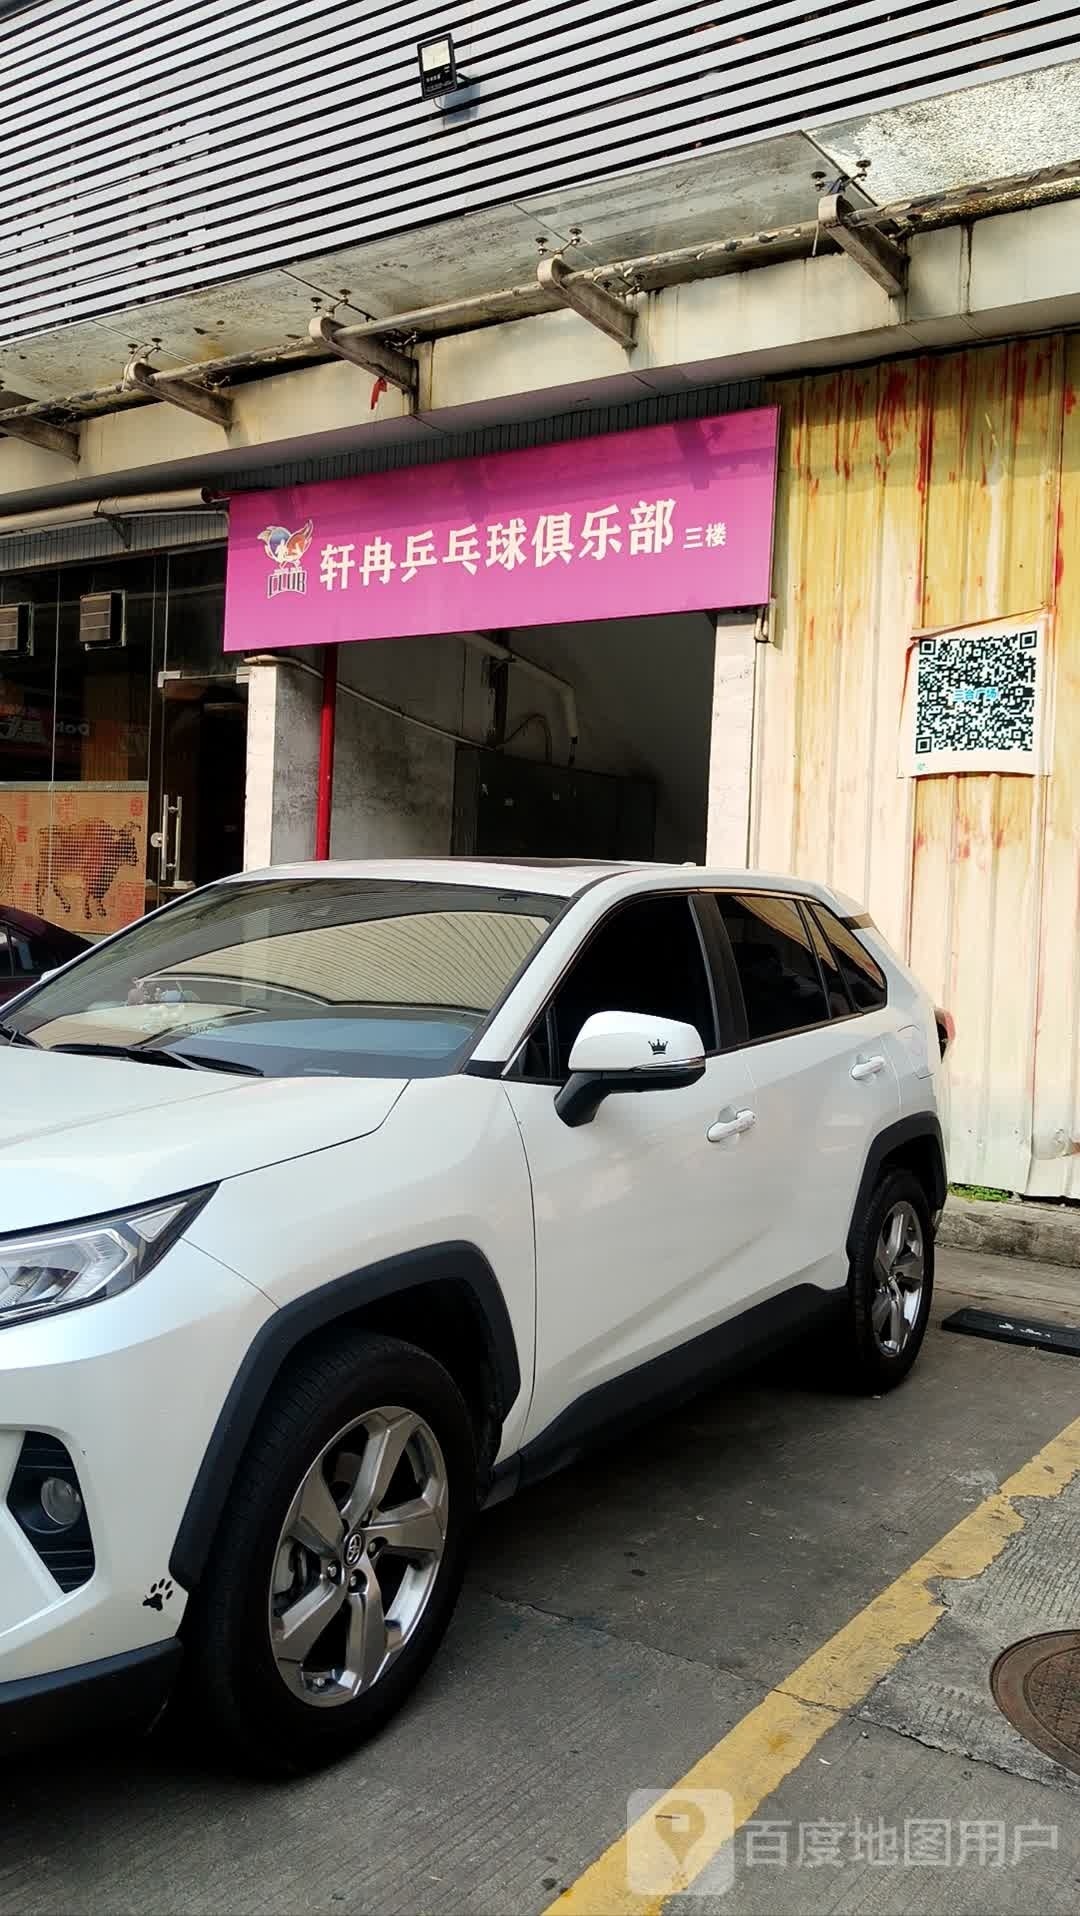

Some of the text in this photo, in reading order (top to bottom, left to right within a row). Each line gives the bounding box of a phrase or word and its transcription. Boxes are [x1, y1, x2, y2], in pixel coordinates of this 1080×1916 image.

[320, 498, 727, 591] 轩冉乒乓球俱乐部 三楼
